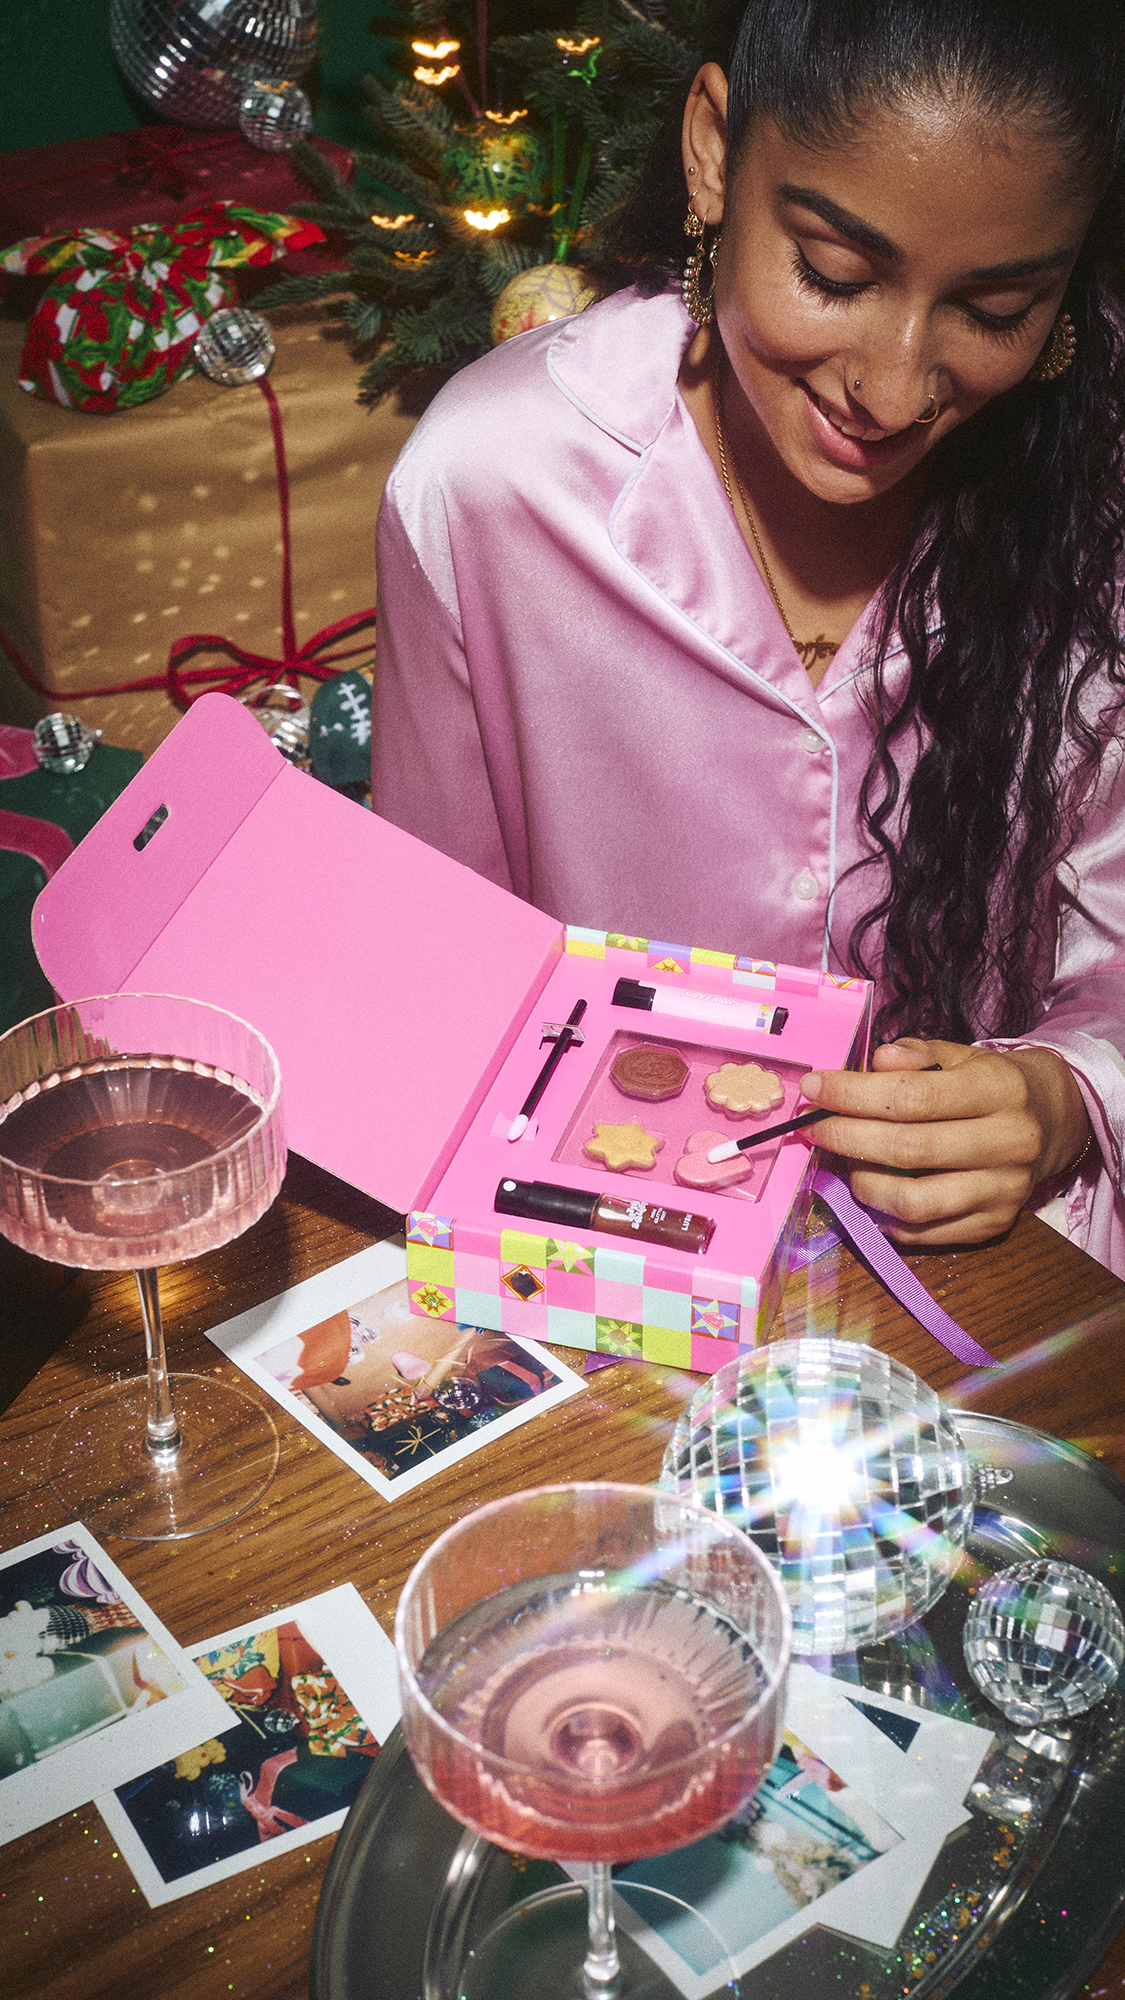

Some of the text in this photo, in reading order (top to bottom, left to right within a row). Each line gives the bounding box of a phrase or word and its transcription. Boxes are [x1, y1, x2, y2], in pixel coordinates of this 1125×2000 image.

[681, 990, 740, 1006] SNOW FAIRY
[681, 1213, 693, 1231] LUSH
